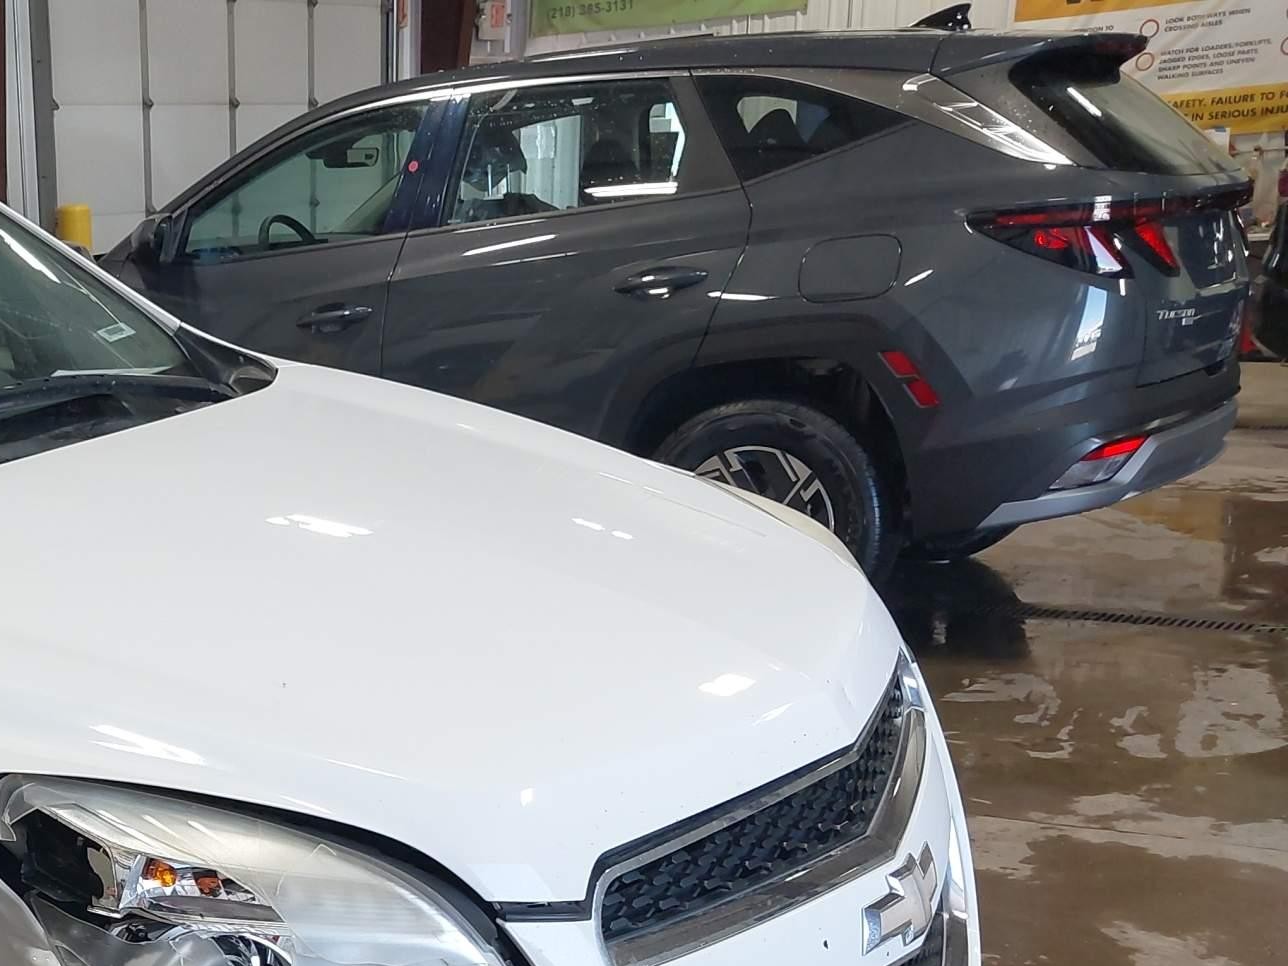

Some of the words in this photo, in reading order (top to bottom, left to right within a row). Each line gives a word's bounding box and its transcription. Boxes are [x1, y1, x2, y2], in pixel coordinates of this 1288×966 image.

[1166, 16, 1184, 25] LOOK
[1206, 10, 1226, 19] WAYS
[1229, 8, 1251, 16] WHEN
[1164, 23, 1199, 32] CROSSING
[1201, 19, 1223, 27] AISLES
[1159, 55, 1186, 64] JAGGED
[1213, 50, 1235, 58] LOOSE
[1160, 48, 1184, 56] WATCH
[1158, 64, 1181, 72] SHARP
[1183, 62, 1207, 70] POINTS
[1227, 57, 1256, 65] UNEVEN
[1157, 71, 1189, 80] WALKING
[1191, 68, 1223, 77] SURFACES
[1168, 98, 1206, 109] AFETY.
[1211, 93, 1256, 106] FAILURE
[1260, 91, 1275, 101] TO
[1191, 112, 1204, 122] IN
[1208, 107, 1256, 120] SERIOUS
